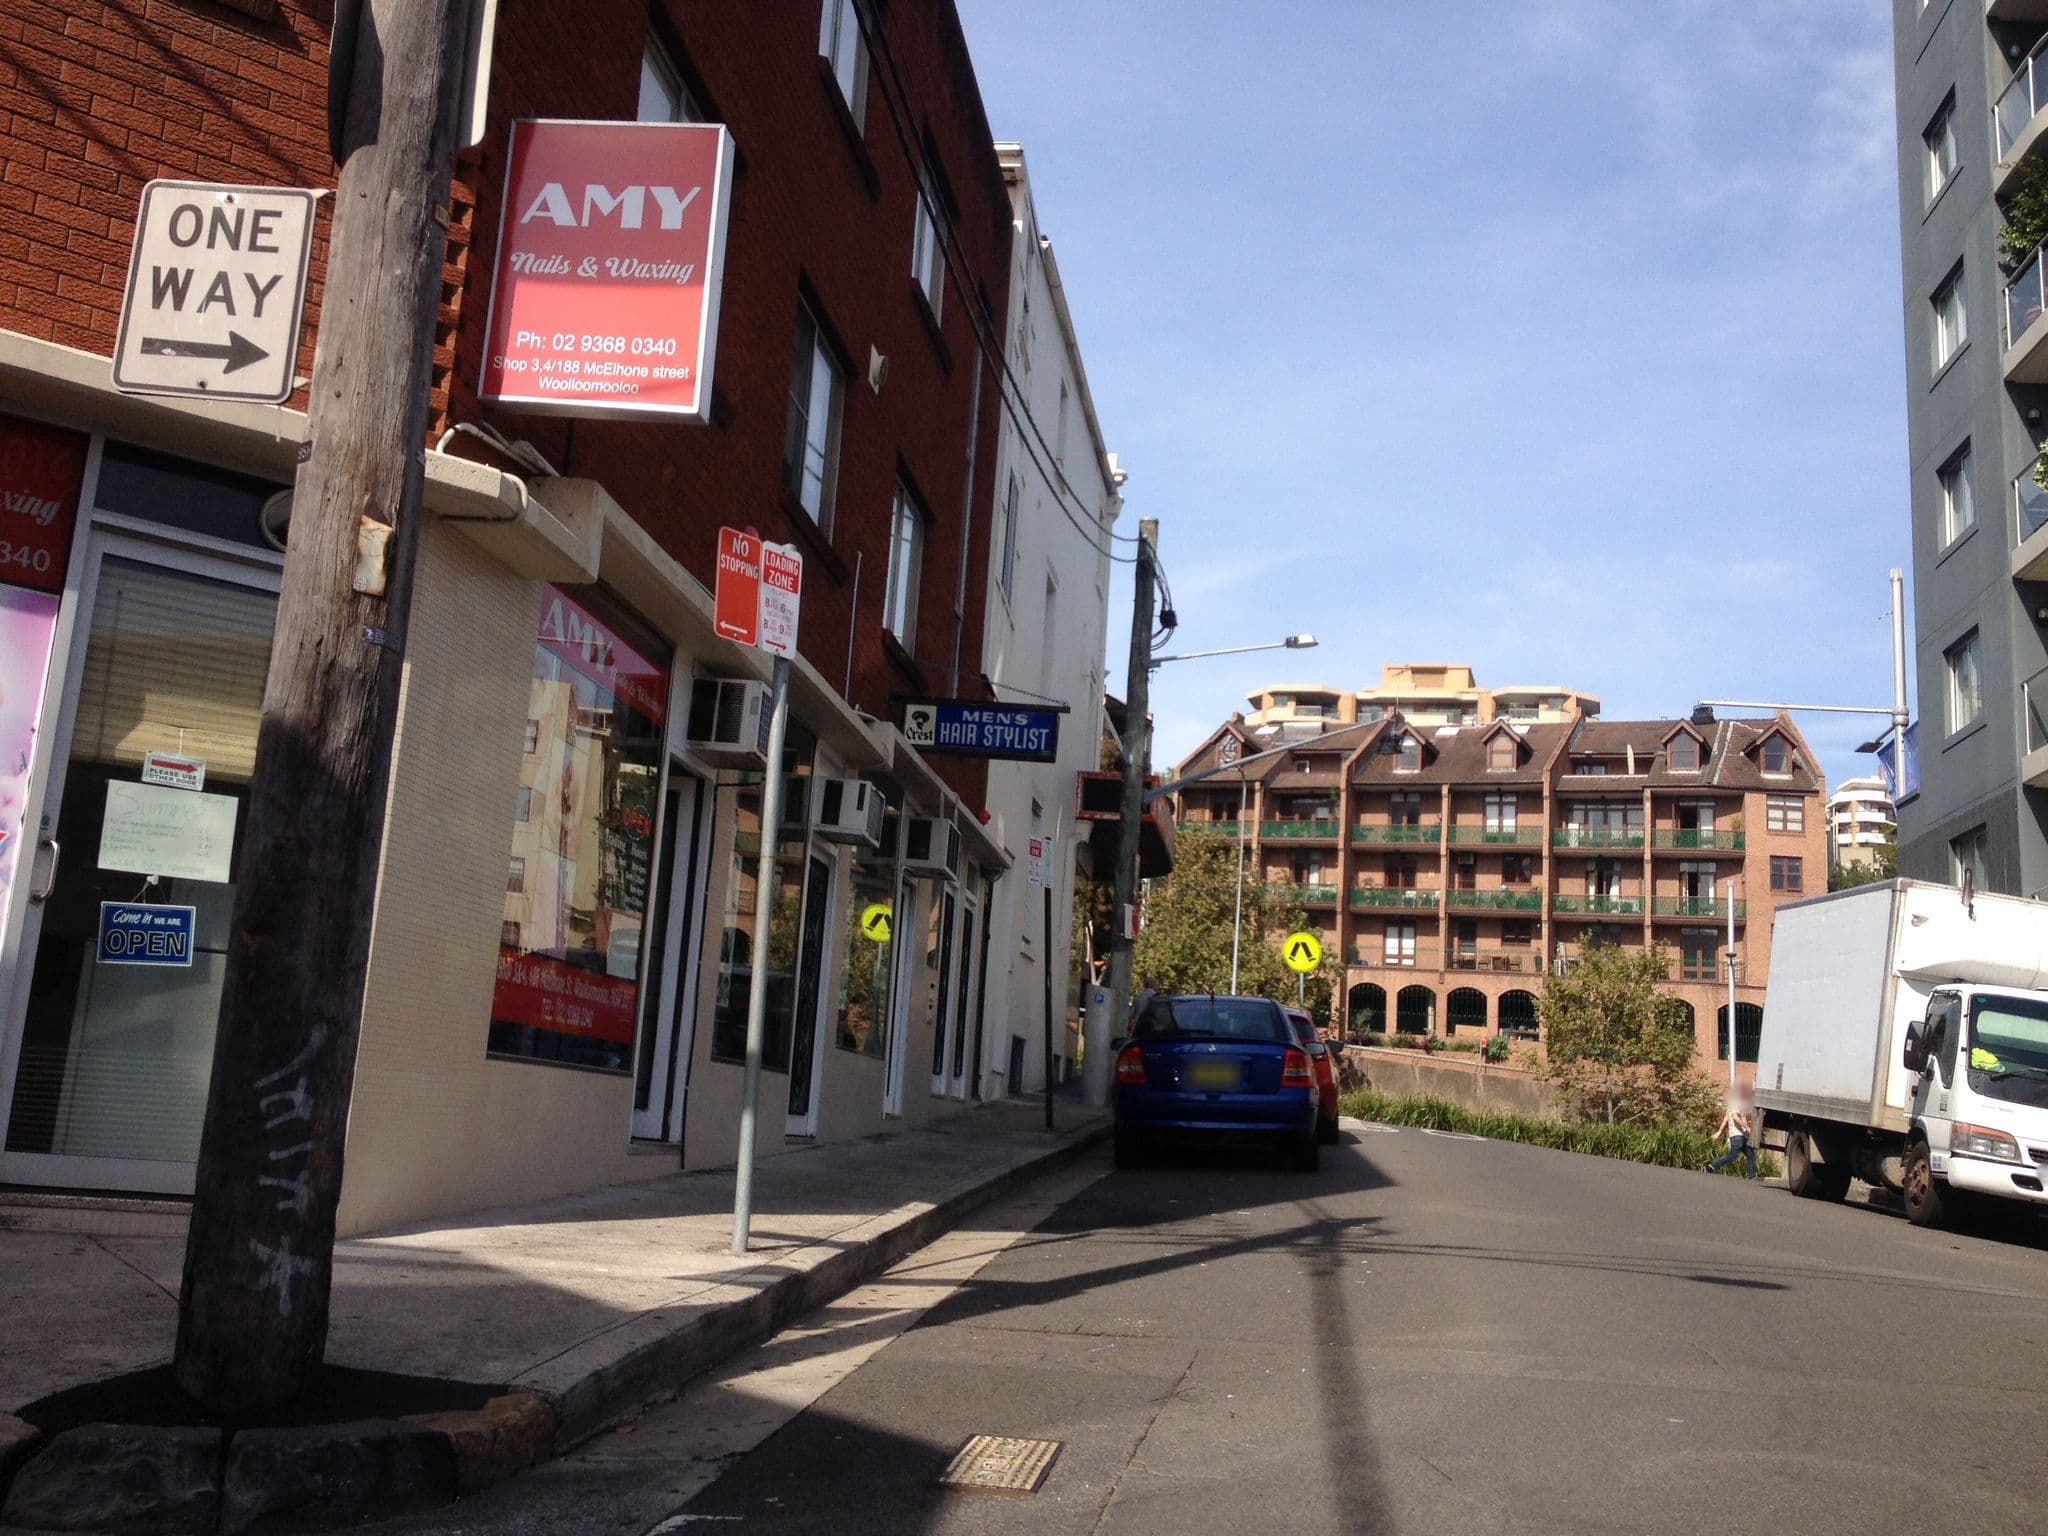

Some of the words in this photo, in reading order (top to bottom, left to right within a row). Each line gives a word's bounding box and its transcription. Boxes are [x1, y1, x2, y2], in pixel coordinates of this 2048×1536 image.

[520, 182, 702, 230] AMY
[168, 203, 283, 254] ONE
[510, 251, 572, 276] Nails
[576, 256, 599, 279] &
[605, 256, 696, 285] Waxing
[151, 265, 285, 319] WAY
[516, 331, 547, 350] Ph:
[552, 334, 576, 351] 02
[580, 335, 626, 353] 9368
[630, 338, 677, 356] 0340
[493, 355, 528, 373] Shop
[584, 361, 649, 378] McElhone
[652, 365, 690, 379] street
[538, 376, 640, 394] Woolloomooloo
[732, 537, 750, 557] NO
[720, 553, 759, 580] STOPPING
[765, 550, 800, 576] LOADING
[768, 569, 794, 592] ZONE
[542, 598, 614, 674] AMY
[962, 710, 1029, 726] MEN'S
[905, 727, 934, 742] Crest
[940, 722, 978, 746] HAIR
[983, 724, 1050, 751] STYLIST
[149, 768, 179, 777] PLEASE
[182, 773, 198, 781] USE
[149, 773, 175, 782] OTHER
[175, 777, 198, 787] DOOR
[112, 909, 142, 925] Come
[141, 911, 153, 926] in
[154, 917, 167, 926] WE
[166, 917, 183, 927] ARE
[105, 928, 187, 958] OPEN
